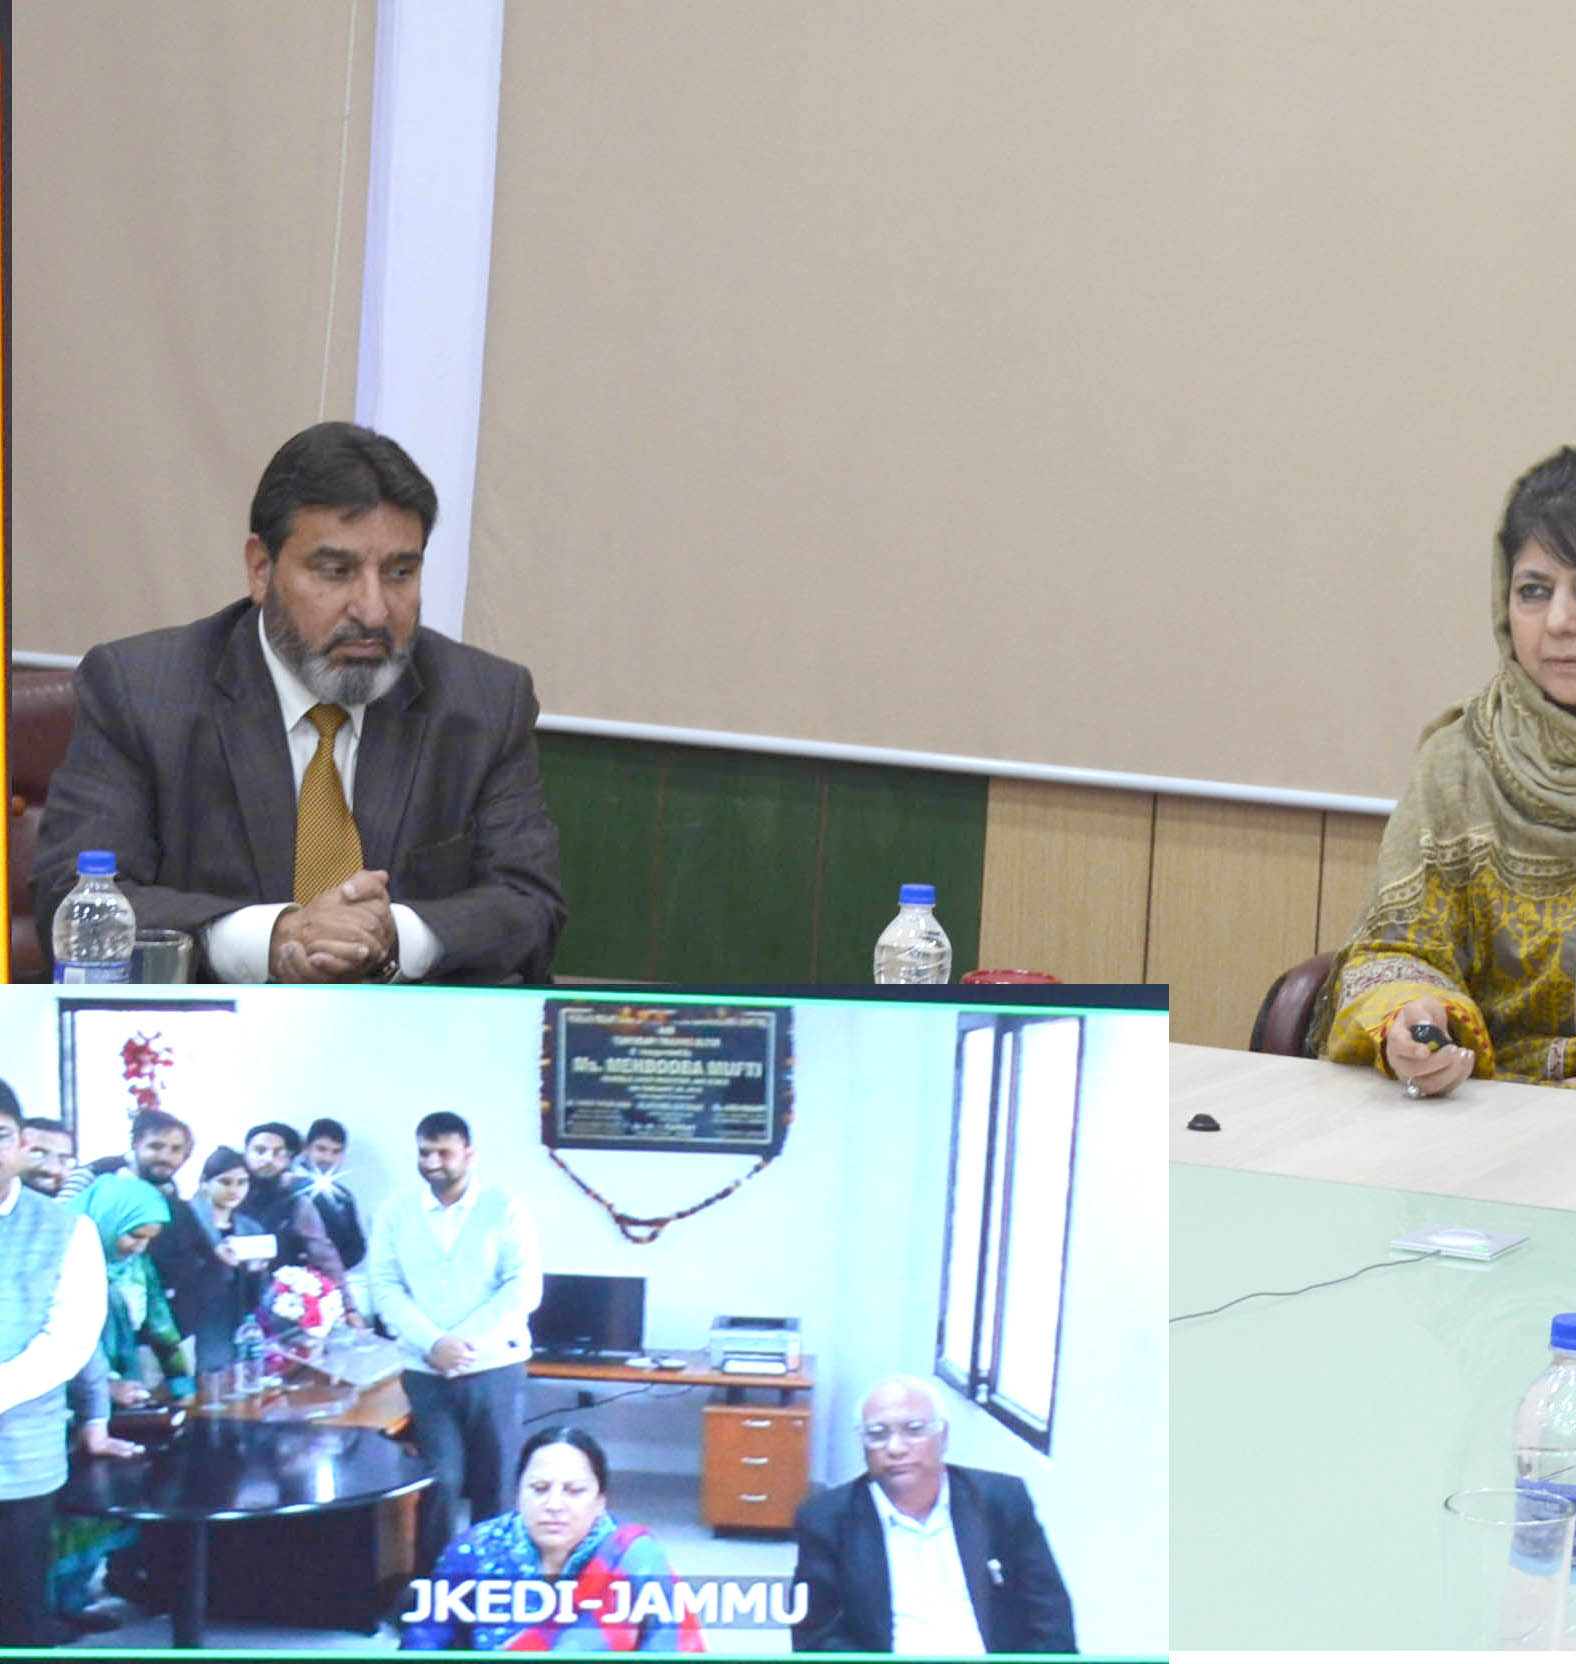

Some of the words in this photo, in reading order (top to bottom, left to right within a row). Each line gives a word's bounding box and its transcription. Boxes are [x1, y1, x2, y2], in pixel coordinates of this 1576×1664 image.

[605, 1058, 705, 1076] MEHBOOBA
[707, 1061, 763, 1079] MUFTI
[402, 1578, 810, 1625] JKEDI-JAMMU
